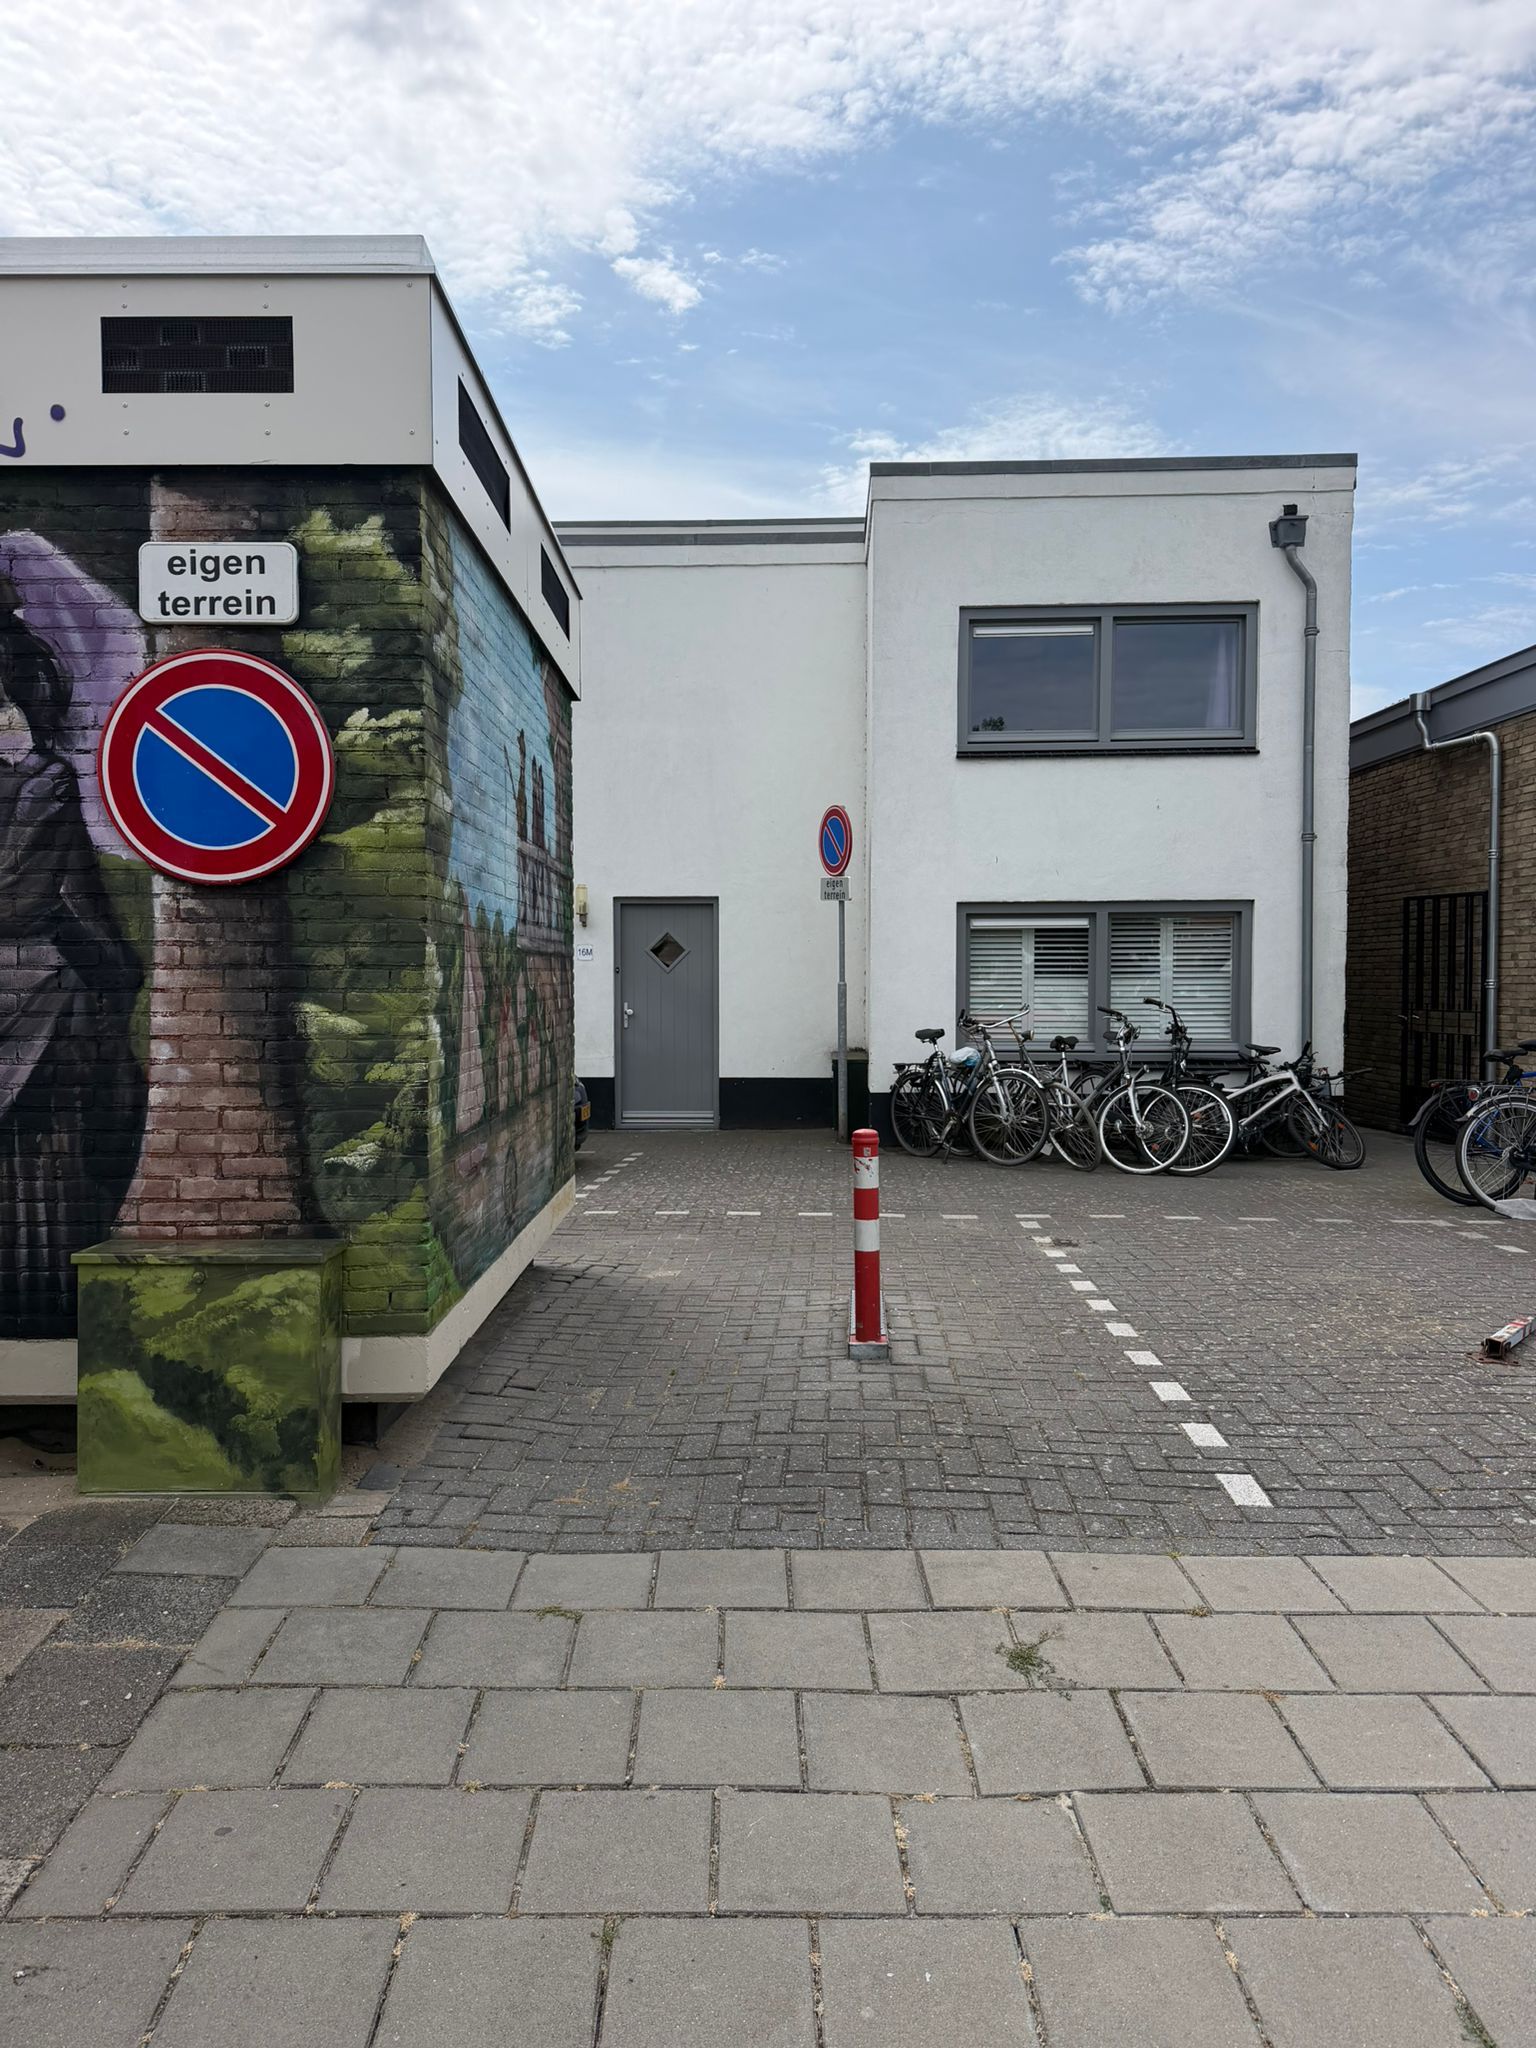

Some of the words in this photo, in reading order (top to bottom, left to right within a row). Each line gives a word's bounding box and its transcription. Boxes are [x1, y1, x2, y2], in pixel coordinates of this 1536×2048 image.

[167, 549, 266, 582] eigen
[158, 589, 276, 616] terrein
[826, 878, 844, 891] eigen
[824, 889, 846, 900] terrein
[577, 948, 593, 957] 16M
